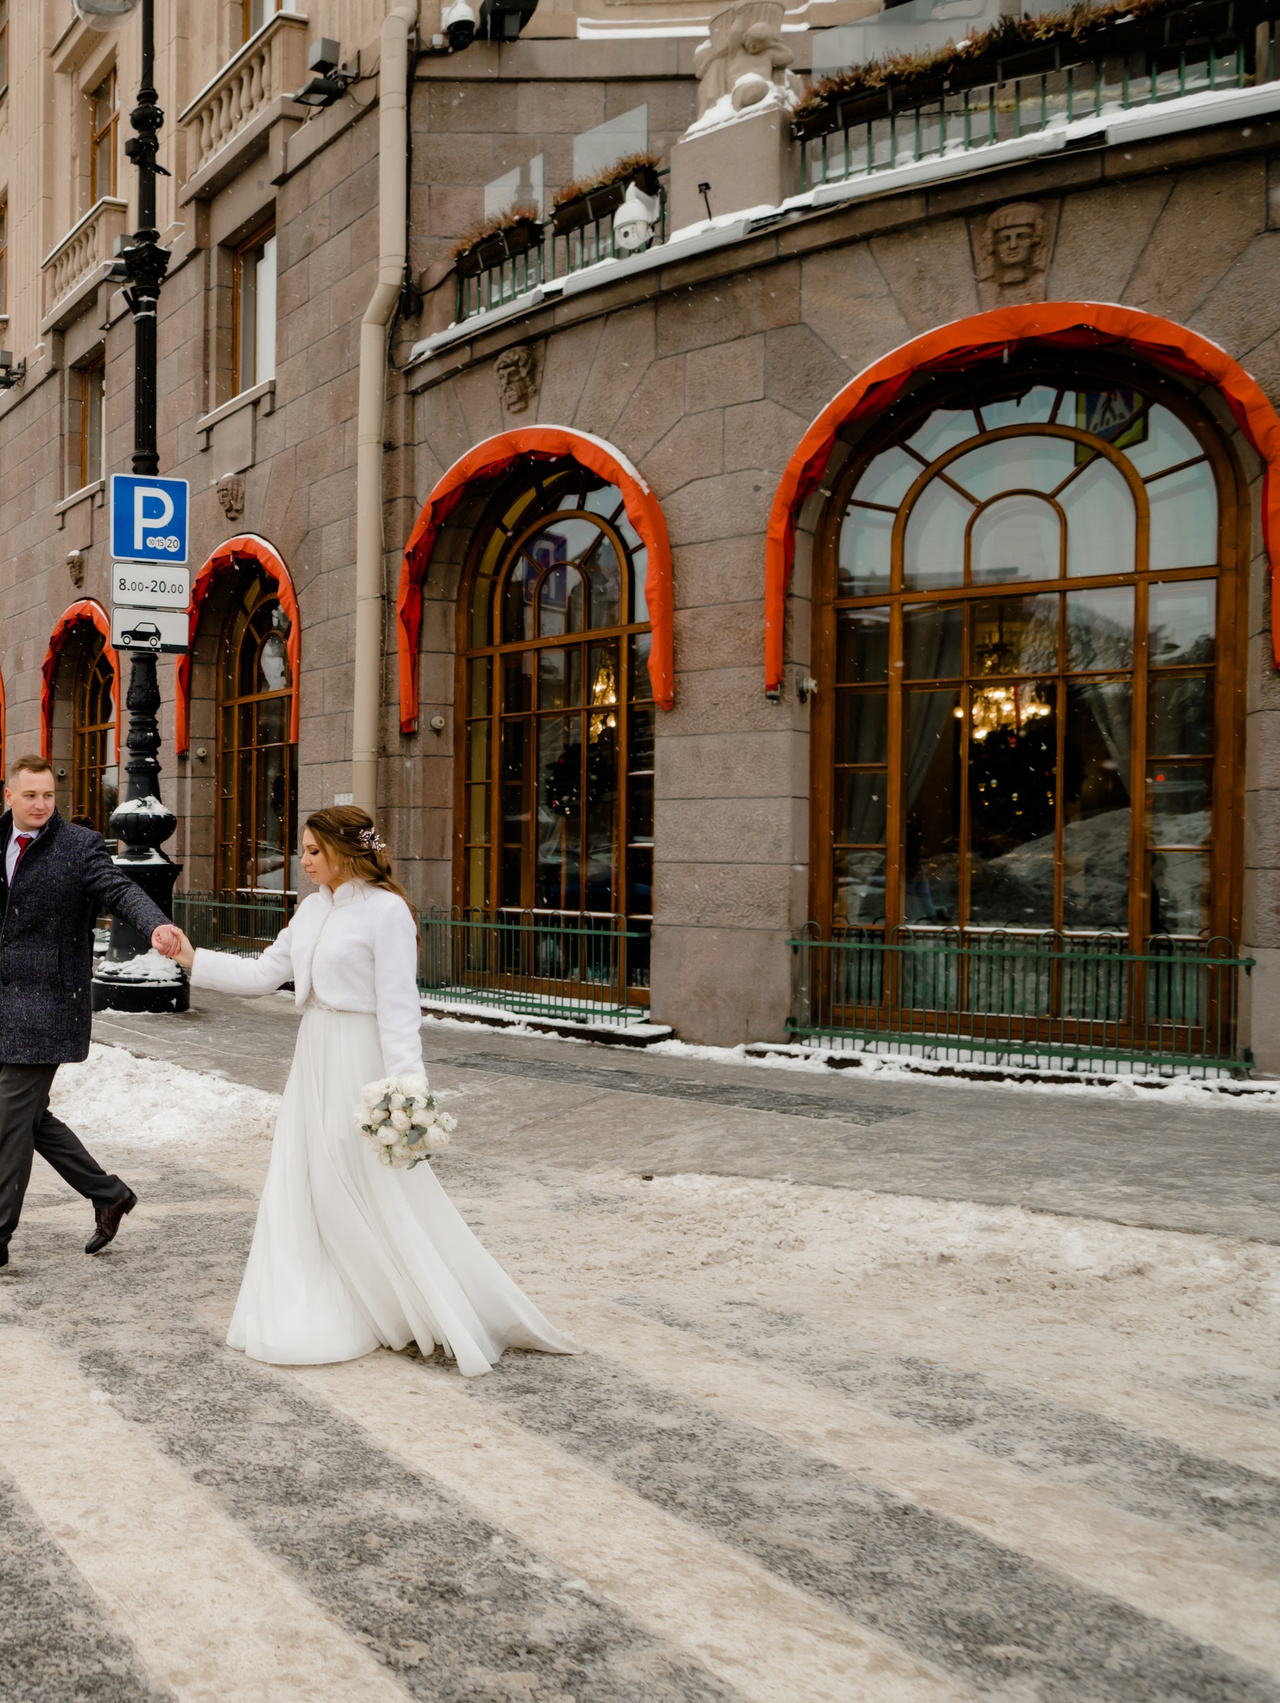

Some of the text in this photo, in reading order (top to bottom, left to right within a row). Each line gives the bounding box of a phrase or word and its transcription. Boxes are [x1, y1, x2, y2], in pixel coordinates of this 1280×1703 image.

[134, 486, 174, 550] P
[157, 538, 164, 547] 15
[167, 538, 179, 549] 20
